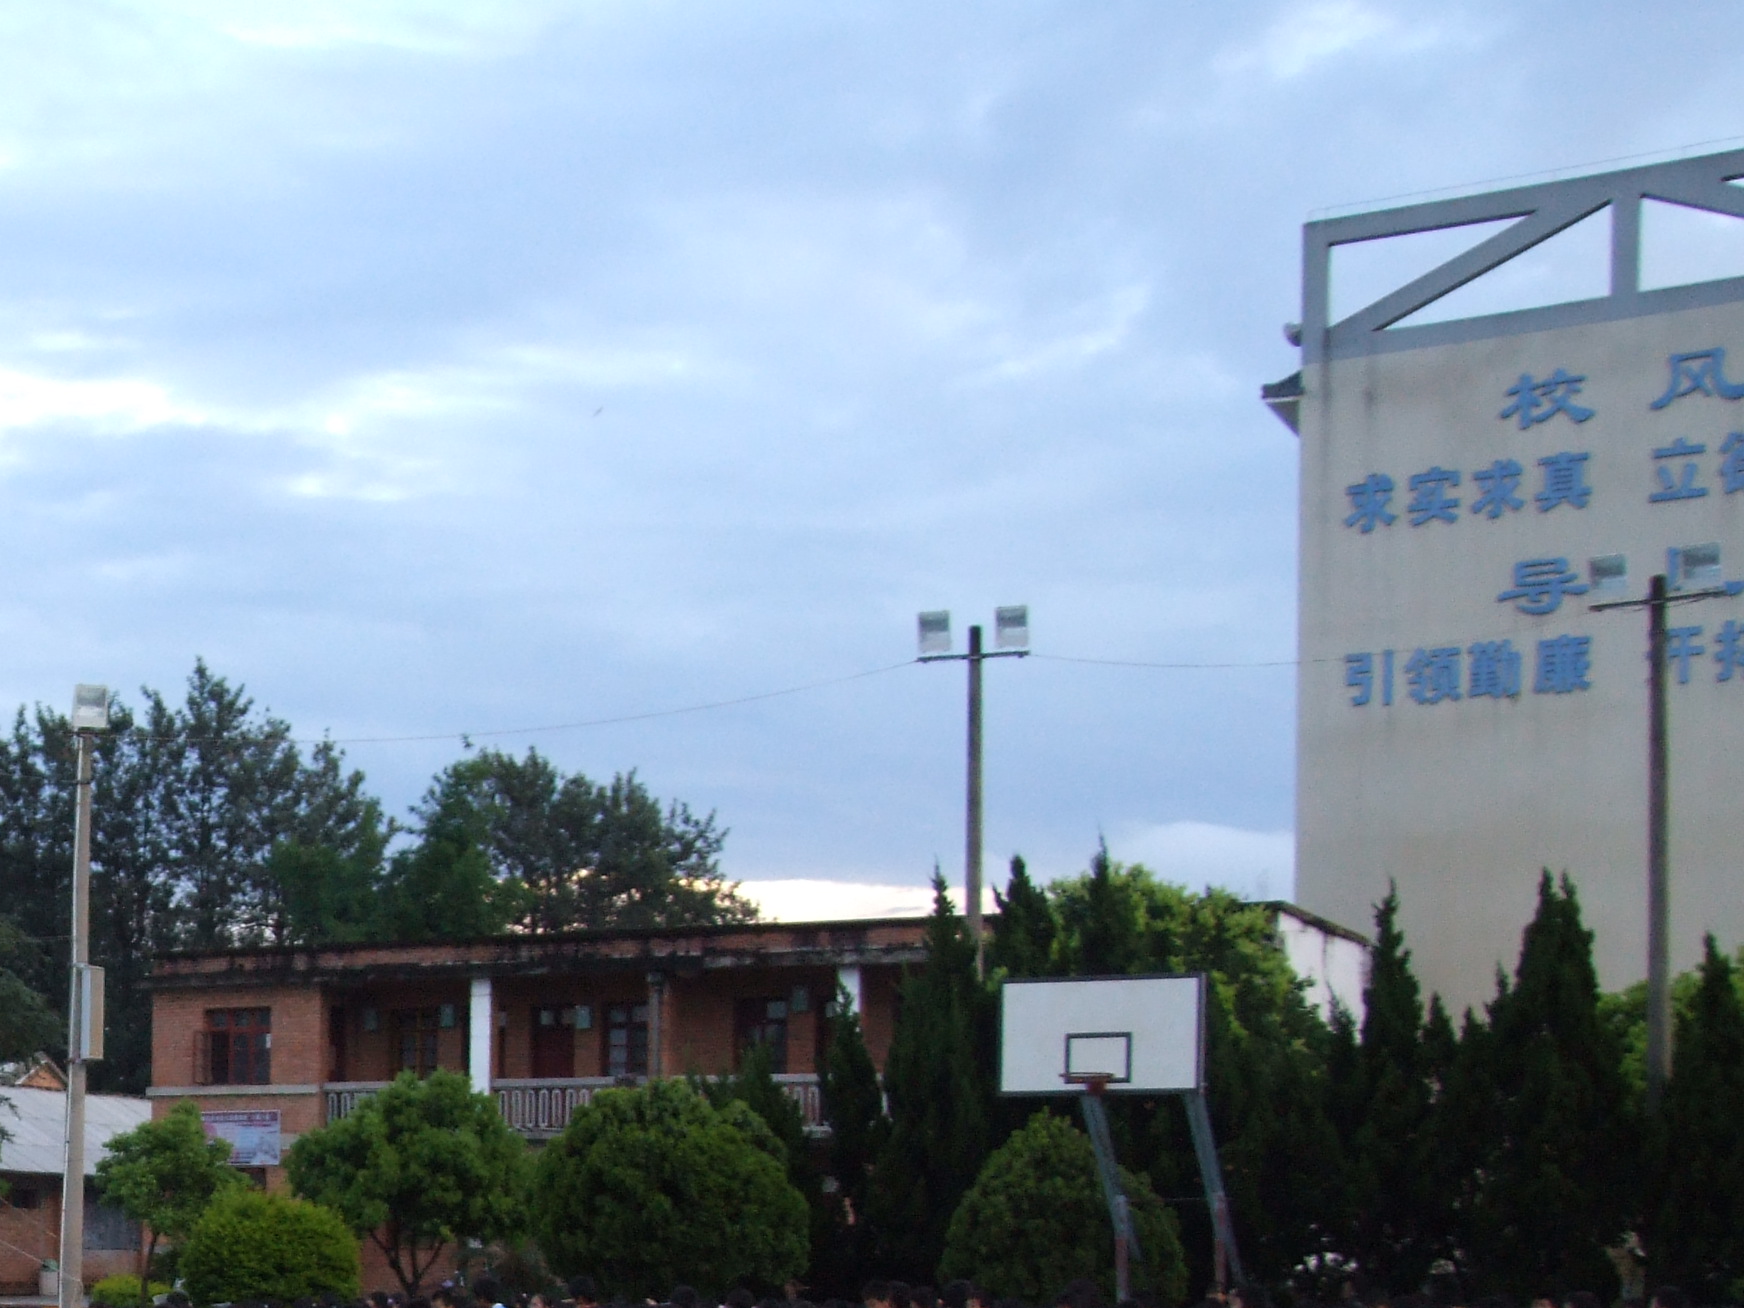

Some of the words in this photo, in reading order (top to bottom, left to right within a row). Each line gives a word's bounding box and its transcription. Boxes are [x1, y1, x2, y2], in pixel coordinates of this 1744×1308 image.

[1344, 451, 1592, 534] 求实求真
[1344, 633, 1592, 707] 引领勤廉
